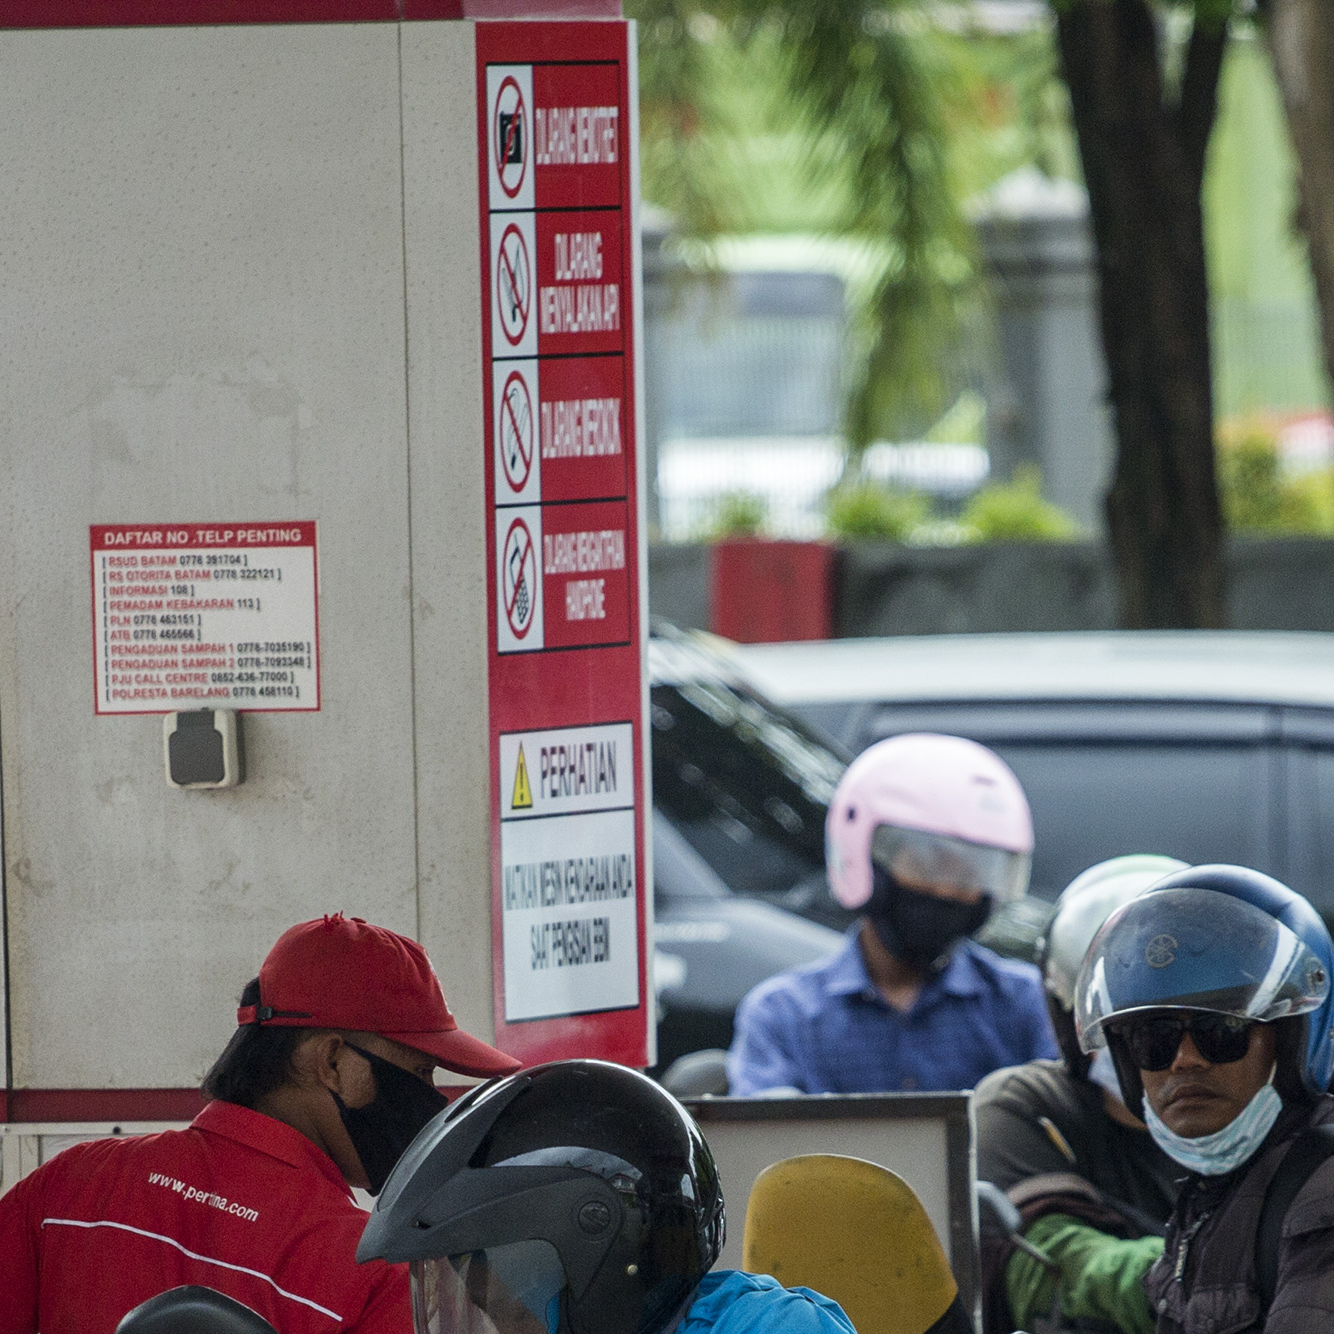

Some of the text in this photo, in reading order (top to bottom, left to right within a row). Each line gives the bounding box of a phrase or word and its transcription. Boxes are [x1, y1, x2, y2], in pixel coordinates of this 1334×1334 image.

[104, 531, 163, 545] DAFTAR
[167, 530, 188, 543] NO
[237, 529, 302, 543] PENTING
[109, 556, 138, 567] RSUD
[142, 555, 177, 566] BATAM
[179, 555, 203, 566] 0778
[109, 571, 124, 582] RS
[126, 571, 171, 581] OTORITA
[175, 570, 211, 580] BATAM
[213, 569, 237, 580] 0778
[110, 585, 189, 596] INFORMASI 108
[110, 599, 254, 611] PEMADAM KEBAKARAN 113
[110, 615, 131, 626] PLN
[133, 615, 157, 626] 0778
[110, 630, 131, 640] ATB
[111, 644, 178, 655] PENGADUAN
[181, 643, 226, 654] SAMPAH
[111, 659, 178, 670] PENGADUAN
[181, 658, 226, 668] SAMPAH
[135, 673, 162, 684] CALL
[166, 673, 207, 683] CENTRE
[112, 688, 167, 699] POLRESTA
[171, 687, 229, 697] BARELANG
[540, 741, 617, 799] PERHATIAN
